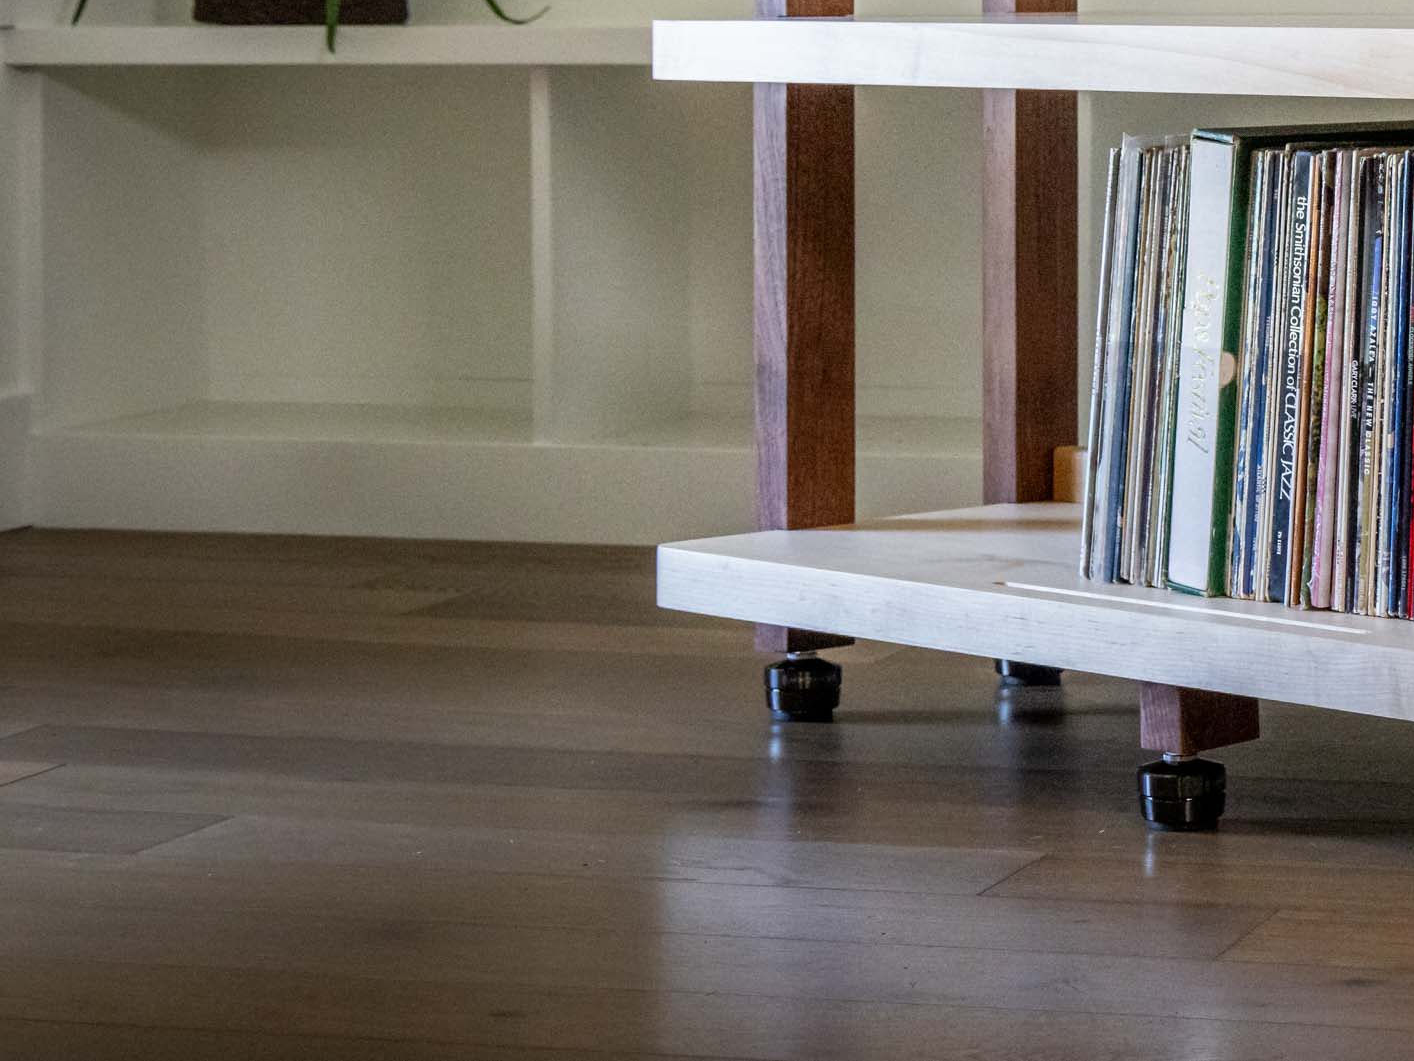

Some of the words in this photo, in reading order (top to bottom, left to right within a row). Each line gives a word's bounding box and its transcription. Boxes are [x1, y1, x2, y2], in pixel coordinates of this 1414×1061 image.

[1296, 196, 1308, 220] the
[1292, 223, 1306, 304] Smithsonian
[1288, 305, 1302, 374] Collection
[1369, 325, 1377, 362] AZALEA
[1286, 376, 1298, 391] of
[1351, 360, 1359, 380] GARY
[1350, 380, 1358, 403] CLARK
[1283, 392, 1297, 455] CLASSIC
[1364, 430, 1372, 476] CLASSIC
[1279, 457, 1293, 501] JAZZ
